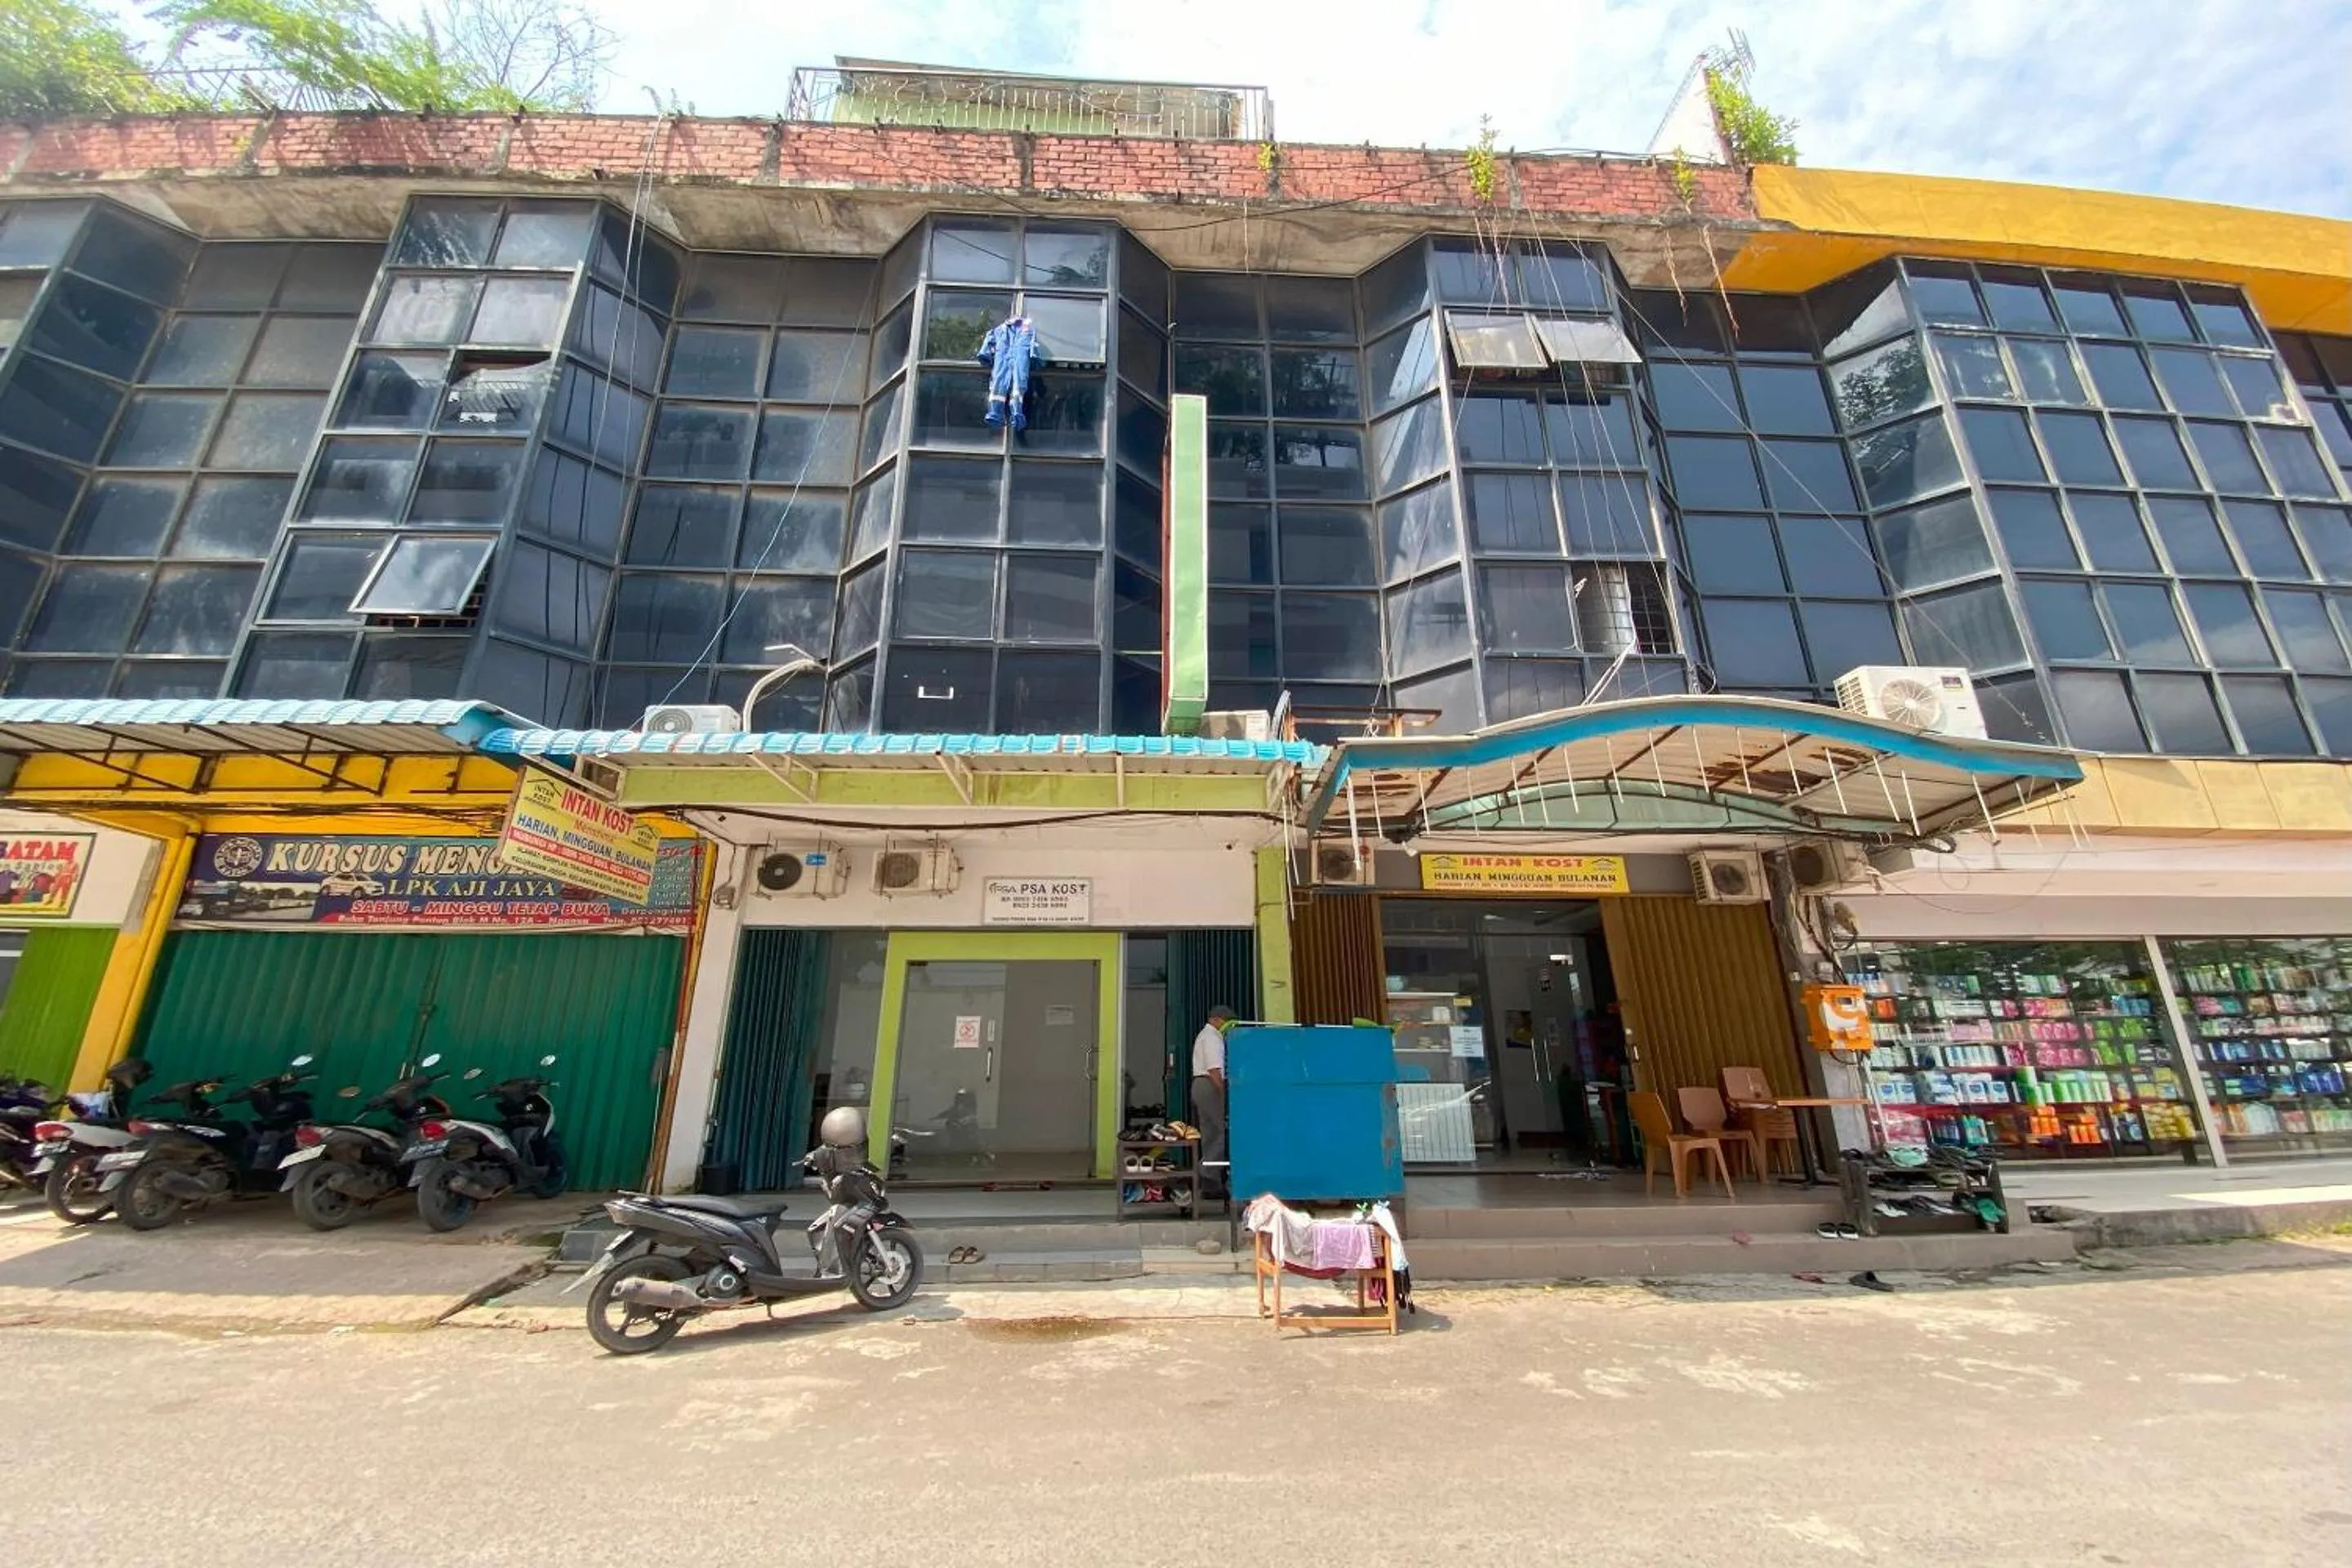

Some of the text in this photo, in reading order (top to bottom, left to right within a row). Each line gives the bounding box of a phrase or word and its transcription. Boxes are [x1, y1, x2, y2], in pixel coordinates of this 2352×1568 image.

[560, 786, 601, 822] INTAN
[603, 804, 635, 836] KOST
[517, 814, 559, 841] HARIAN,
[616, 850, 652, 871] BULANAN
[266, 842, 407, 874] KURSUS
[1462, 856, 1585, 868] INTAN KOST
[1433, 871, 1618, 883] HARIAN MINGGUAN BULANAN
[388, 878, 556, 898] LPK AJI JAYA
[1020, 883, 1047, 894] PSA
[1051, 883, 1087, 895] KOST
[350, 899, 409, 914] SABTU
[423, 900, 503, 915] MINGGU
[506, 902, 559, 915] TETAP
[560, 902, 612, 916] BUKA
